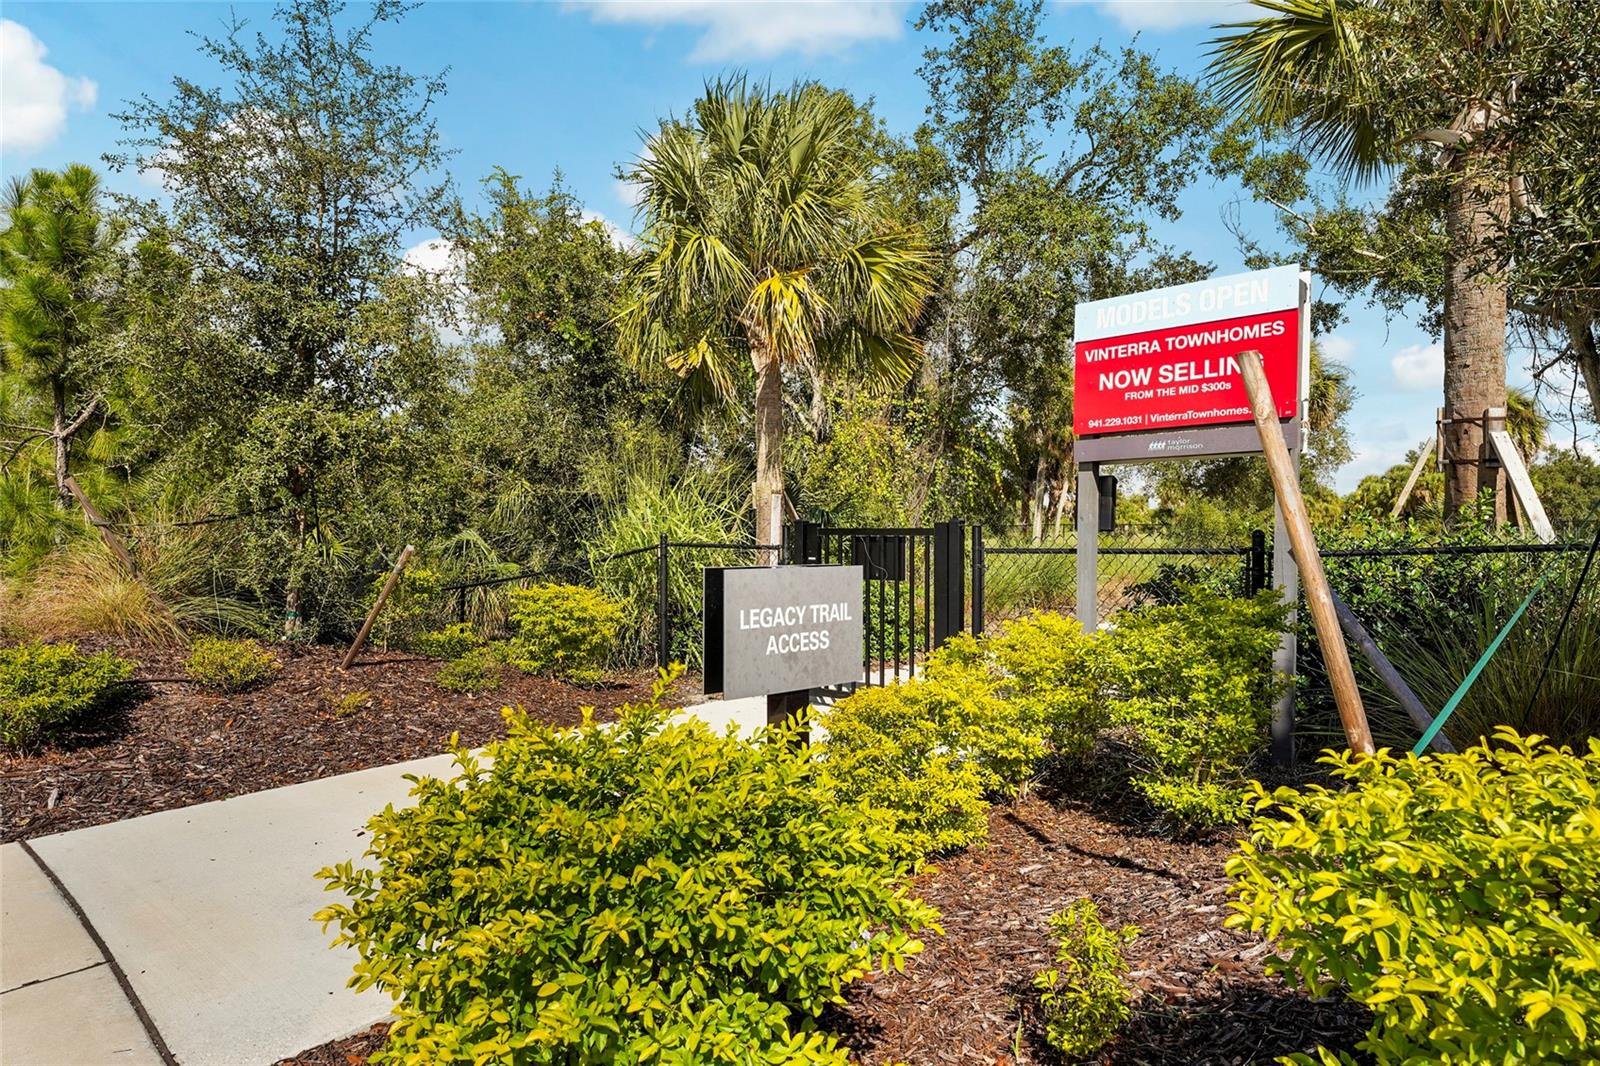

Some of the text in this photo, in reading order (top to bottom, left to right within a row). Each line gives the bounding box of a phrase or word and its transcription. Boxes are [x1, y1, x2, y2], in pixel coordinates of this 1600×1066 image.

[1097, 278, 1270, 329] MODELS OPEN
[1085, 320, 1285, 363] VINTERRA TOWNHOMES
[1099, 367, 1152, 391] NOW
[1124, 381, 1232, 401] FROM THE MID $300s
[1088, 415, 1142, 428] 941.229.1031
[1150, 405, 1252, 422] VinterraTownhomes.
[1167, 438, 1190, 447] taylor
[739, 602, 852, 630] LEGACY TRAIL
[766, 630, 830, 656] ACCESS
